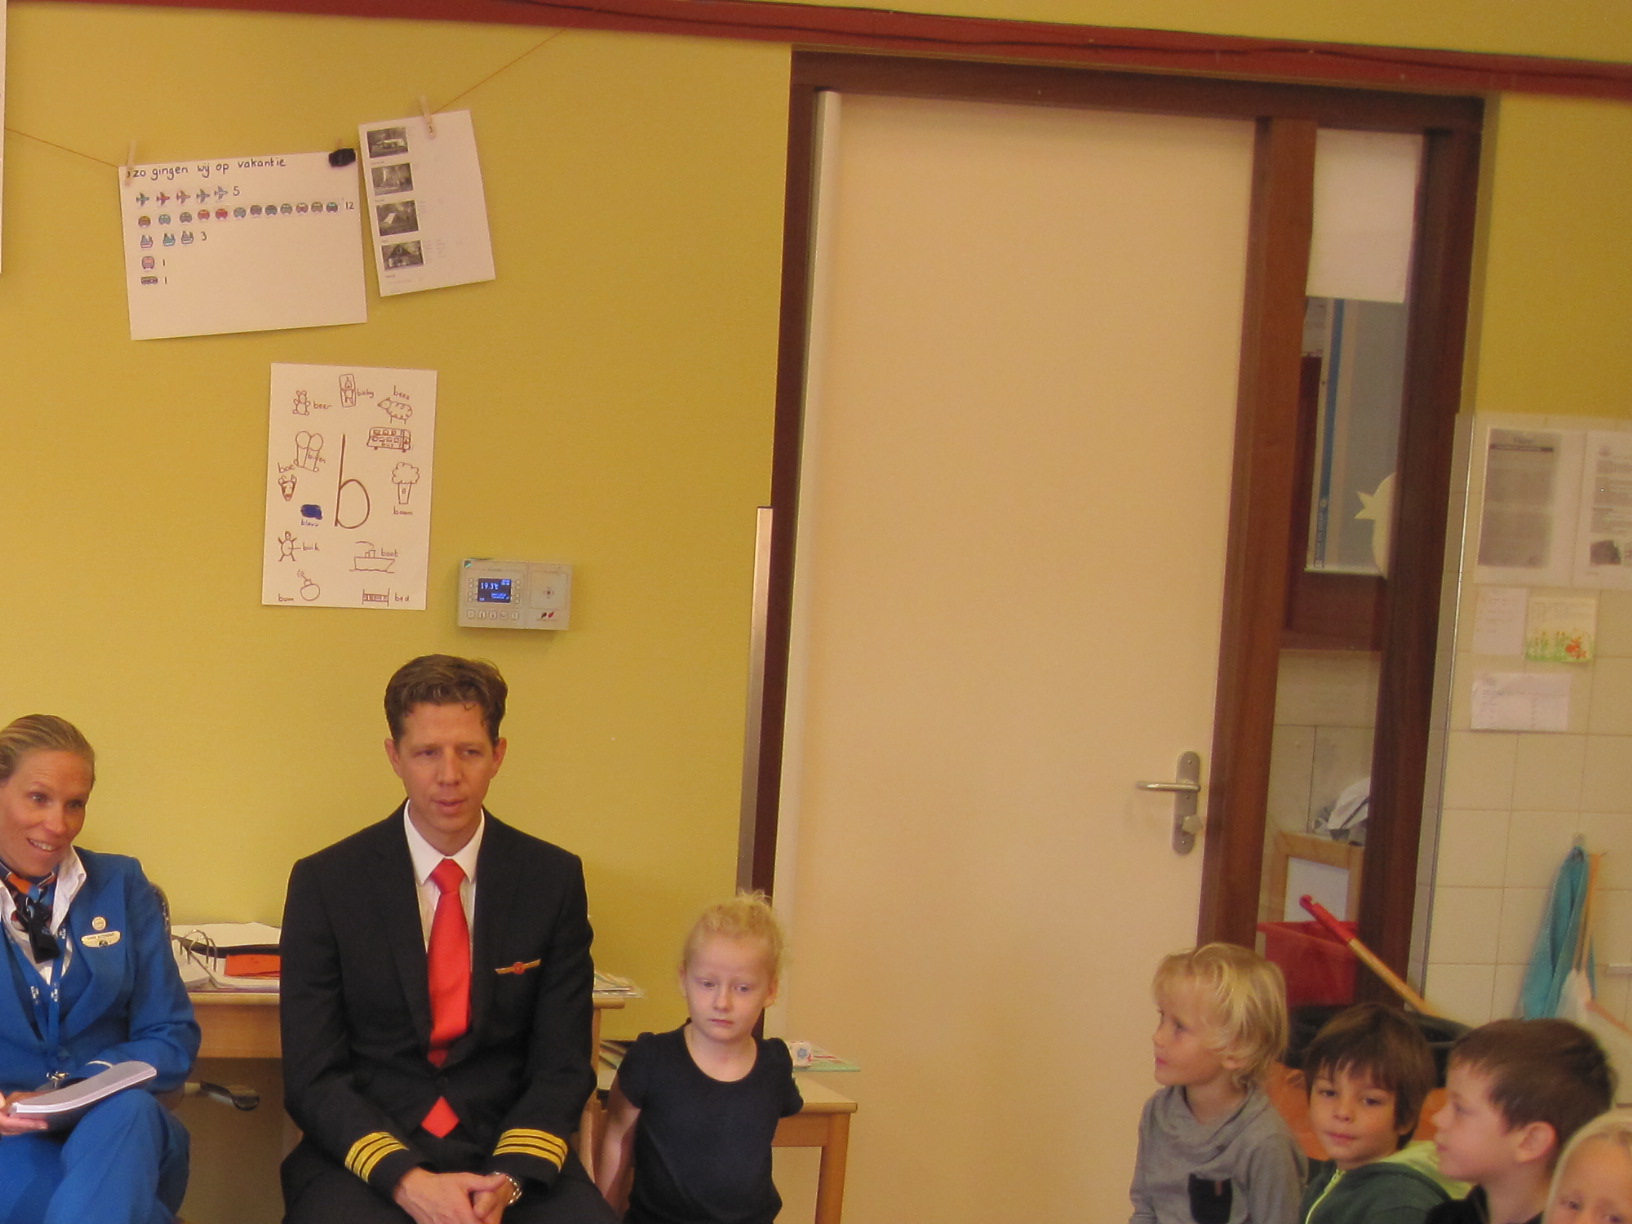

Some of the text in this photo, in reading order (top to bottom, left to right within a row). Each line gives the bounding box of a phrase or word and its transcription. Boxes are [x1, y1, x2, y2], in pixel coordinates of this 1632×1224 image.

[132, 157, 286, 181] zo gingen wij op vakantie
[232, 185, 240, 196] 5
[345, 201, 355, 211] 12
[200, 231, 207, 241] 3
[356, 388, 375, 398] baby
[334, 434, 371, 529] b
